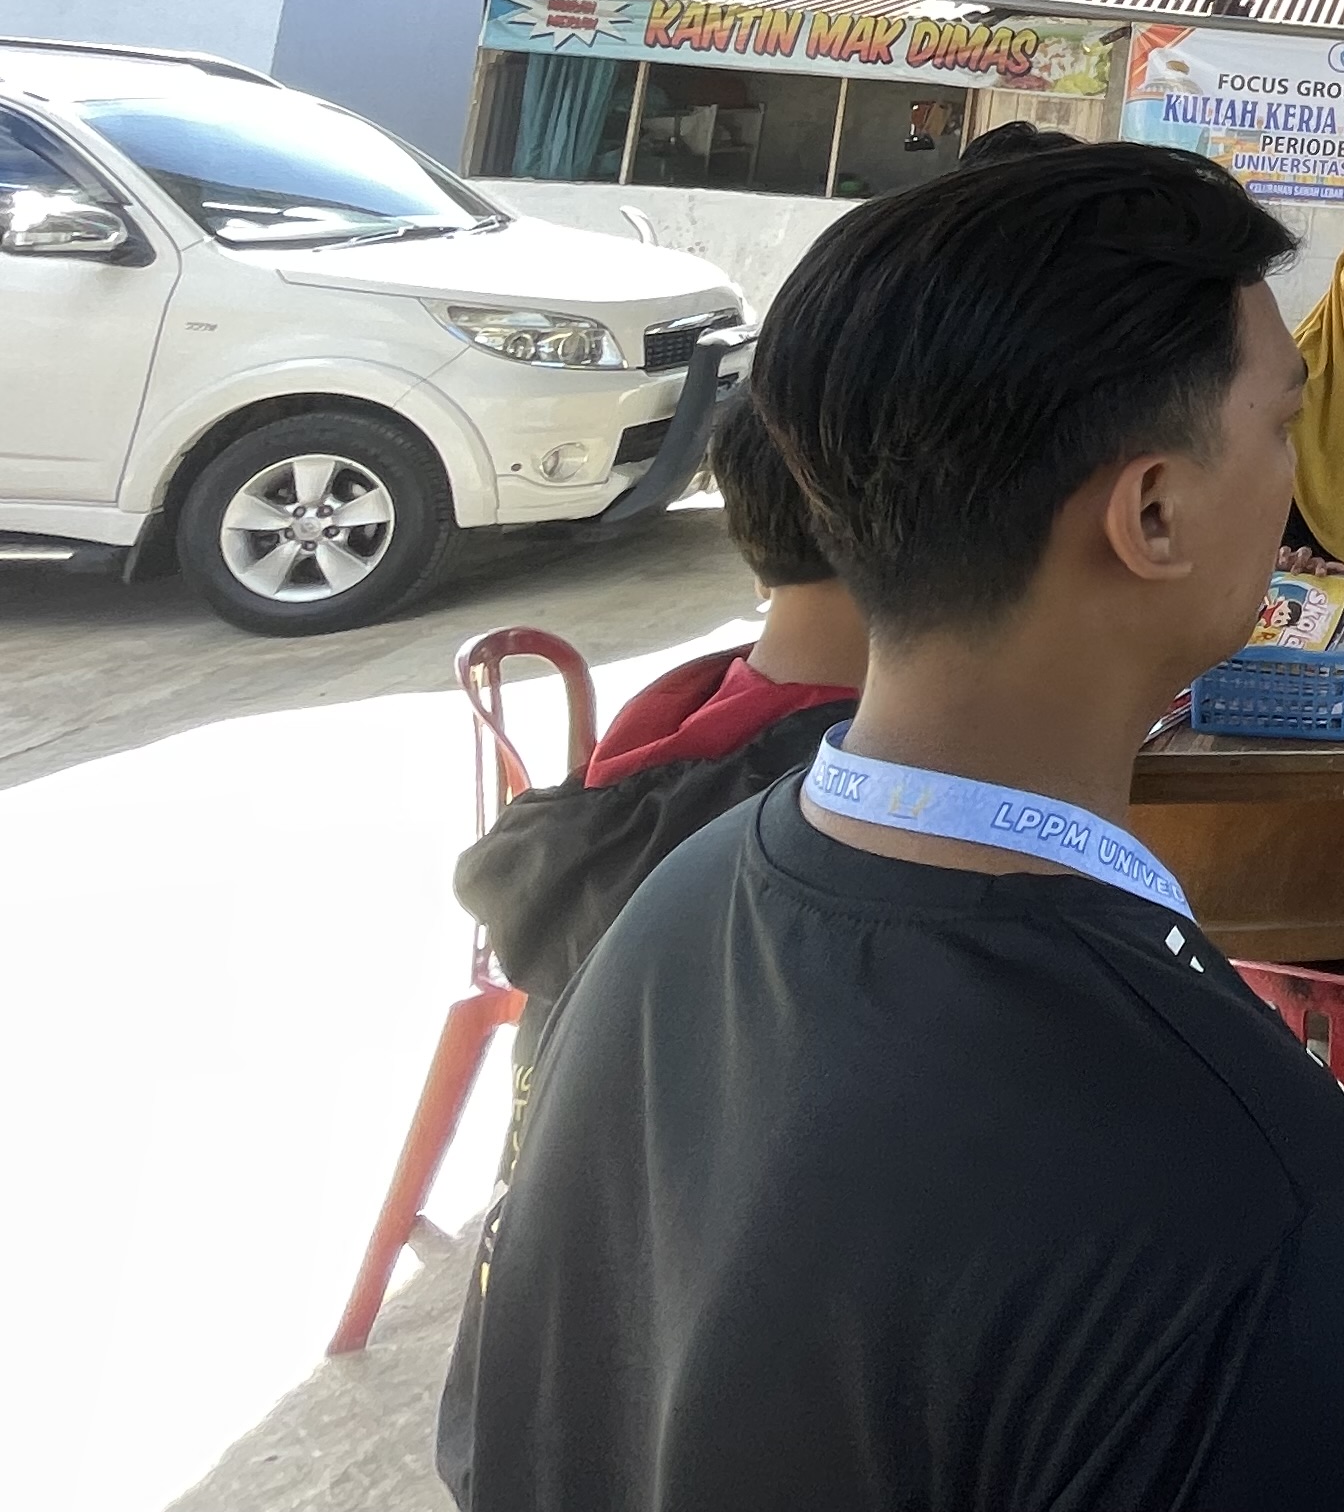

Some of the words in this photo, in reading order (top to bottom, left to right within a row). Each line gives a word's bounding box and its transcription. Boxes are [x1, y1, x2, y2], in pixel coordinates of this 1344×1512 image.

[806, 10, 906, 64] MAK
[906, 17, 1039, 76] DIMAS
[1218, 73, 1289, 95] FOCUS
[1163, 93, 1258, 129] KULIAH
[1263, 101, 1337, 134] KERJA
[990, 801, 1093, 853] LPPM
